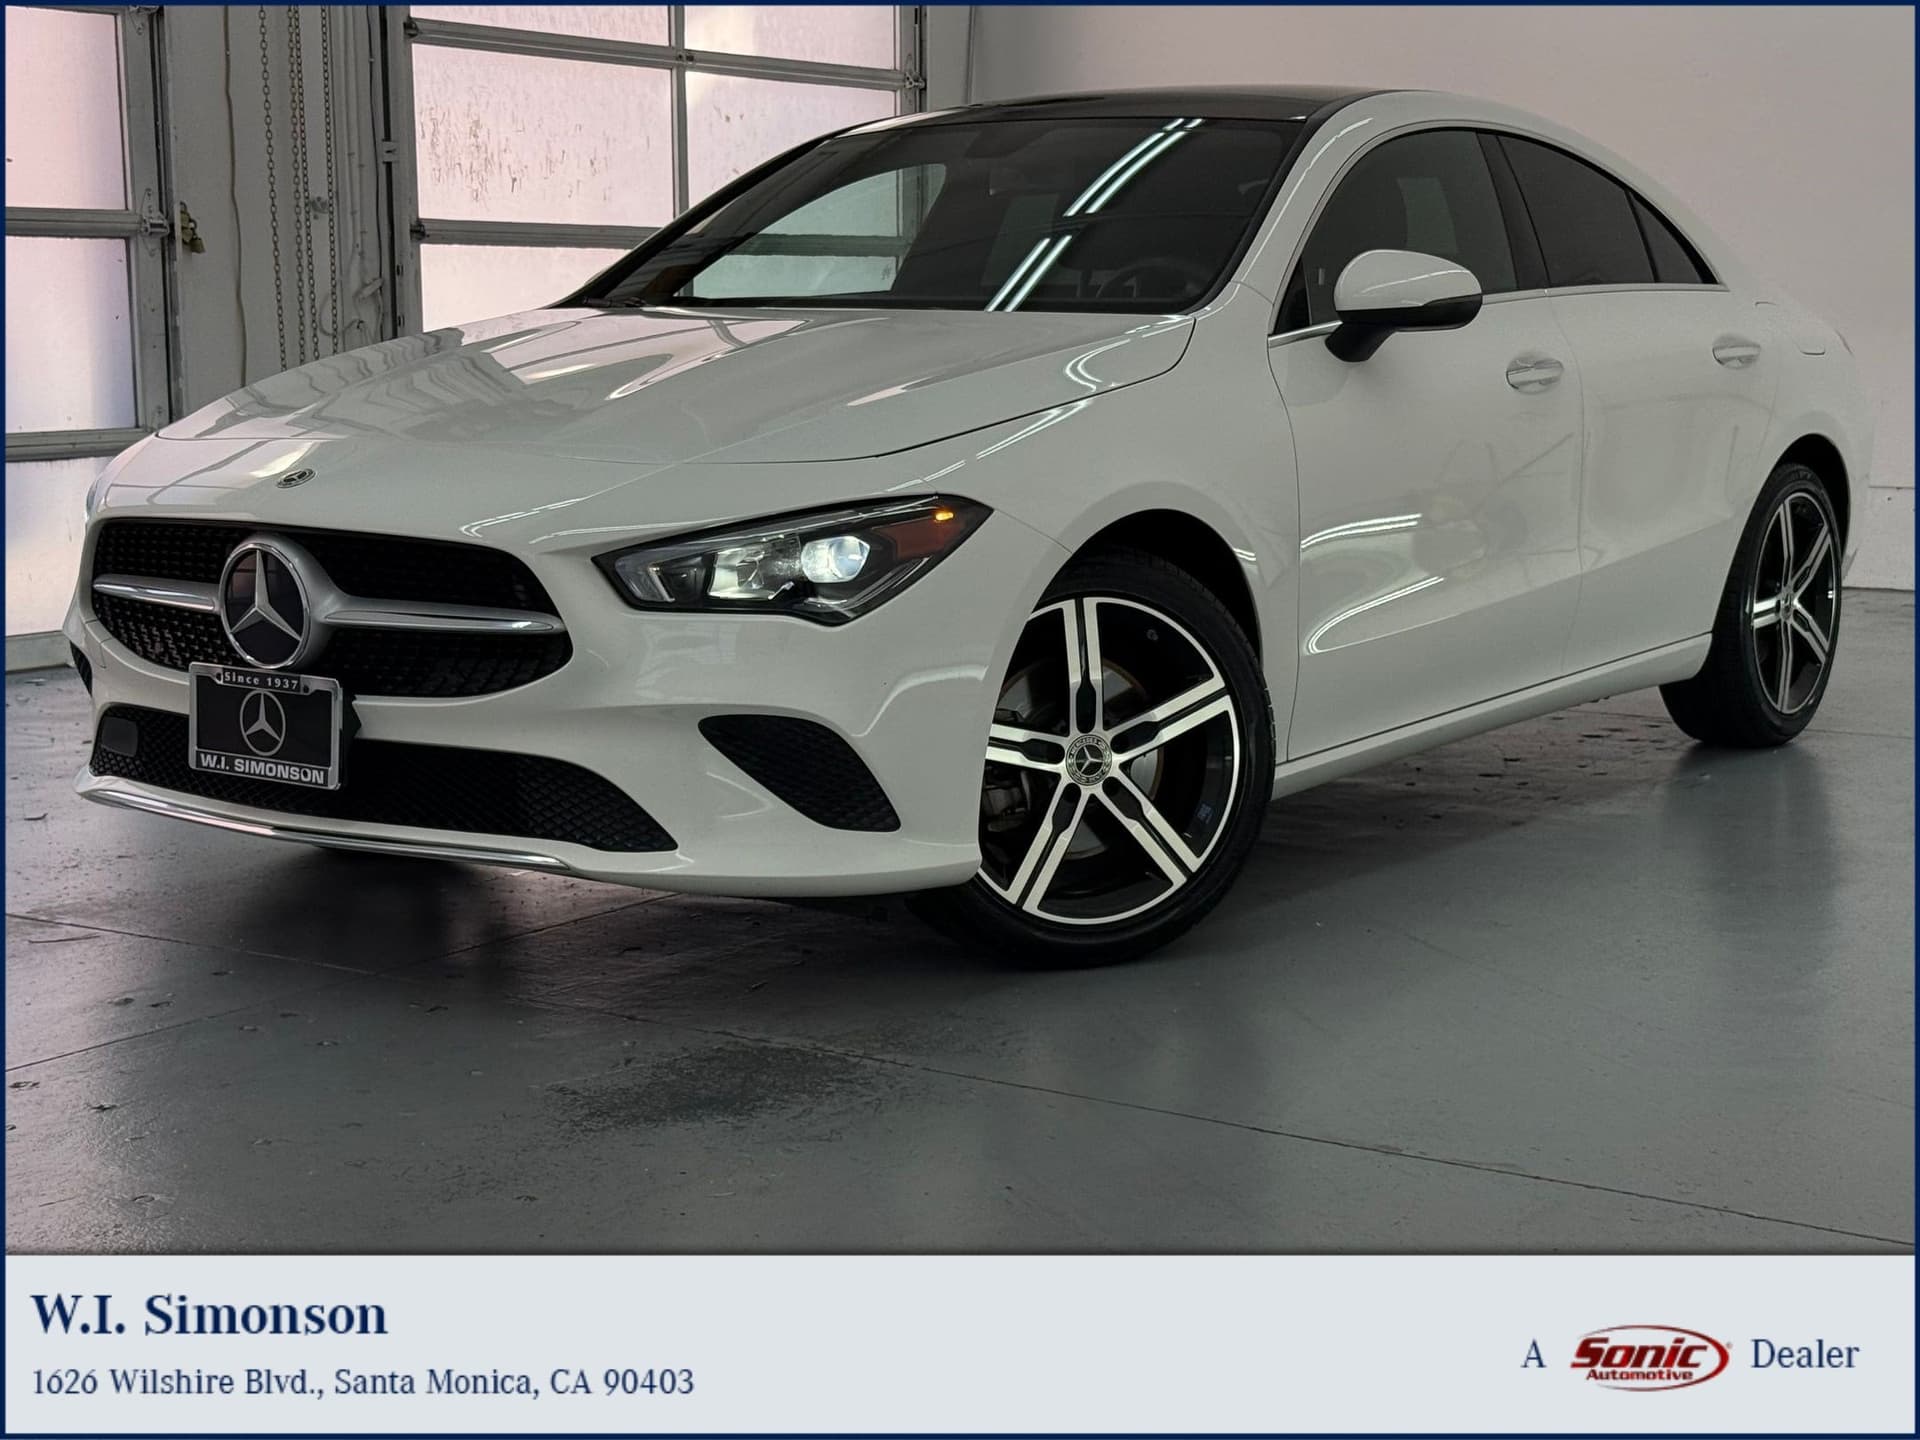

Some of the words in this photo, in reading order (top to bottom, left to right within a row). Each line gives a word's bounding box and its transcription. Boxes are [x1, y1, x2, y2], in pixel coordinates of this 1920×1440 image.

[224, 671, 260, 686] Since
[266, 677, 298, 690] 1937
[200, 753, 230, 771] W.I.
[233, 758, 325, 785] SIMONSON
